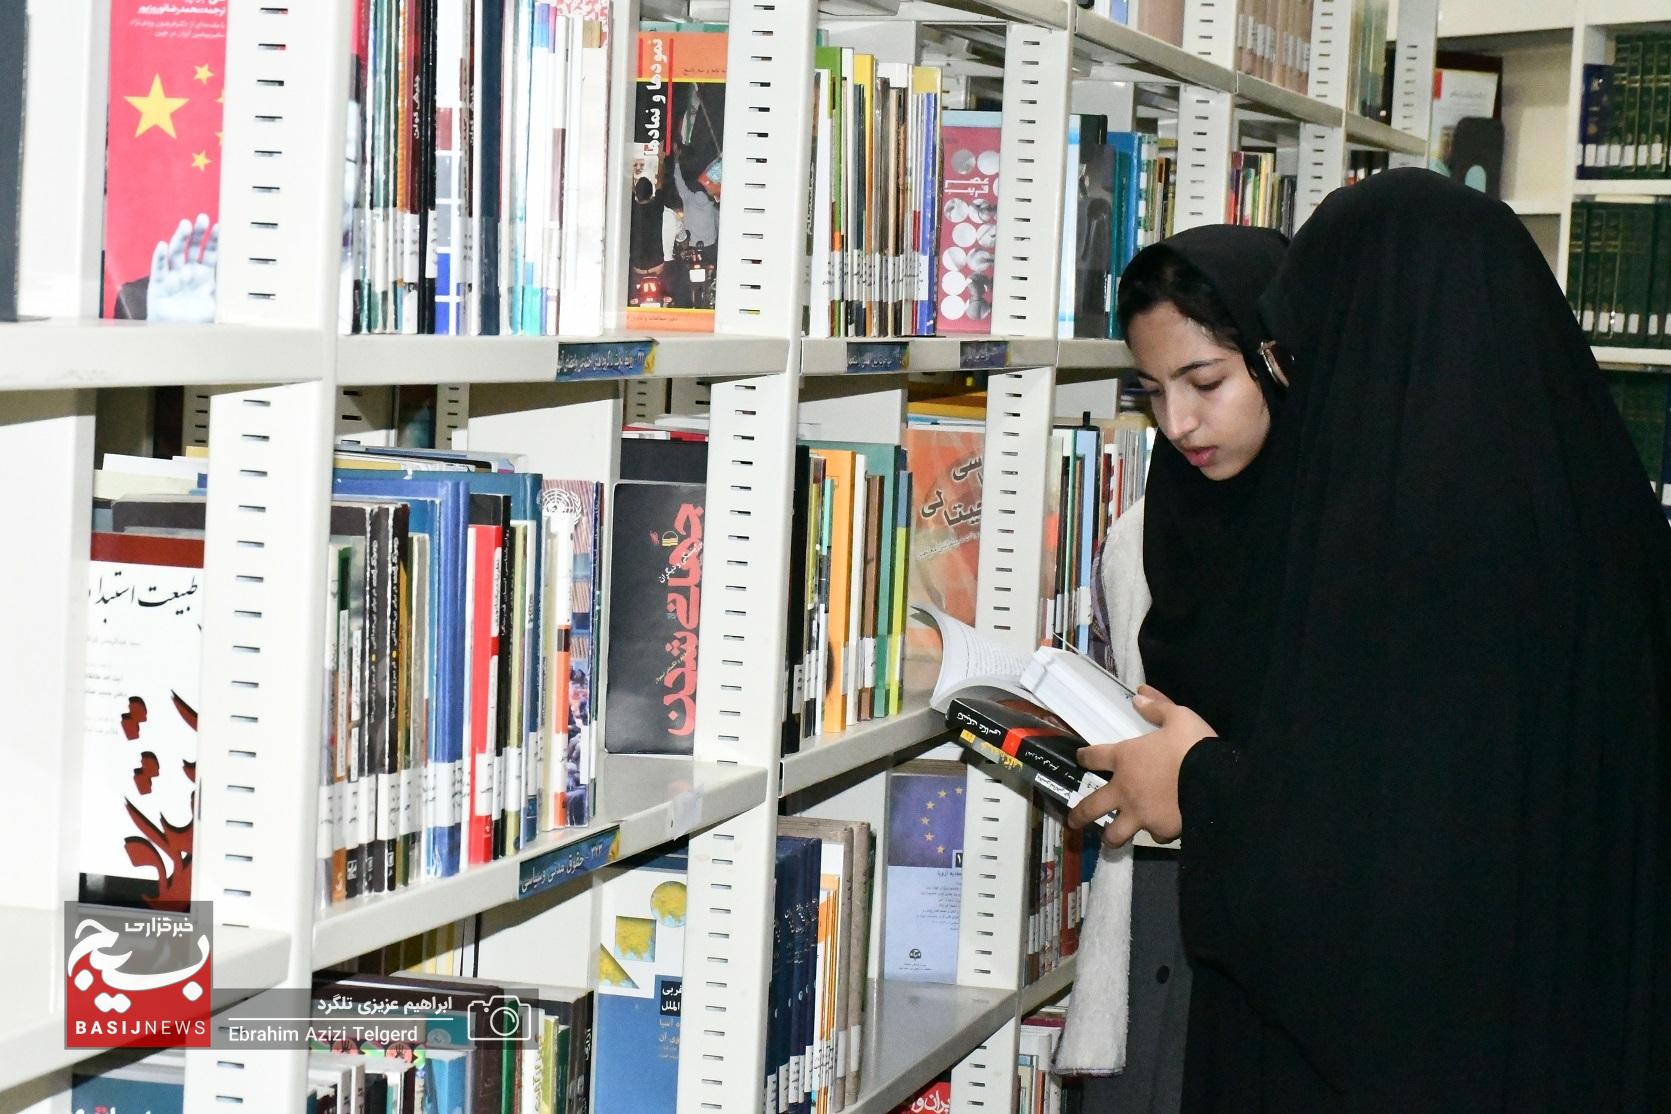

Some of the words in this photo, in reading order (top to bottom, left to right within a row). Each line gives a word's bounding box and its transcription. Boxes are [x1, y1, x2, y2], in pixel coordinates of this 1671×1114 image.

[646, 38, 668, 90] نمودها
[652, 94, 666, 105] و
[643, 108, 661, 156] نمادها
[667, 503, 705, 630] جهانی
[88, 571, 136, 624] استبدا
[137, 576, 198, 616] طبیعت
[663, 631, 699, 736] شدن
[979, 723, 1002, 737] عکاسی
[548, 863, 565, 883] مدنی
[566, 851, 584, 874] حقوق
[521, 866, 542, 893] سیاسی
[661, 1001, 680, 1012] الملل
[925, 1090, 950, 1114] یران
